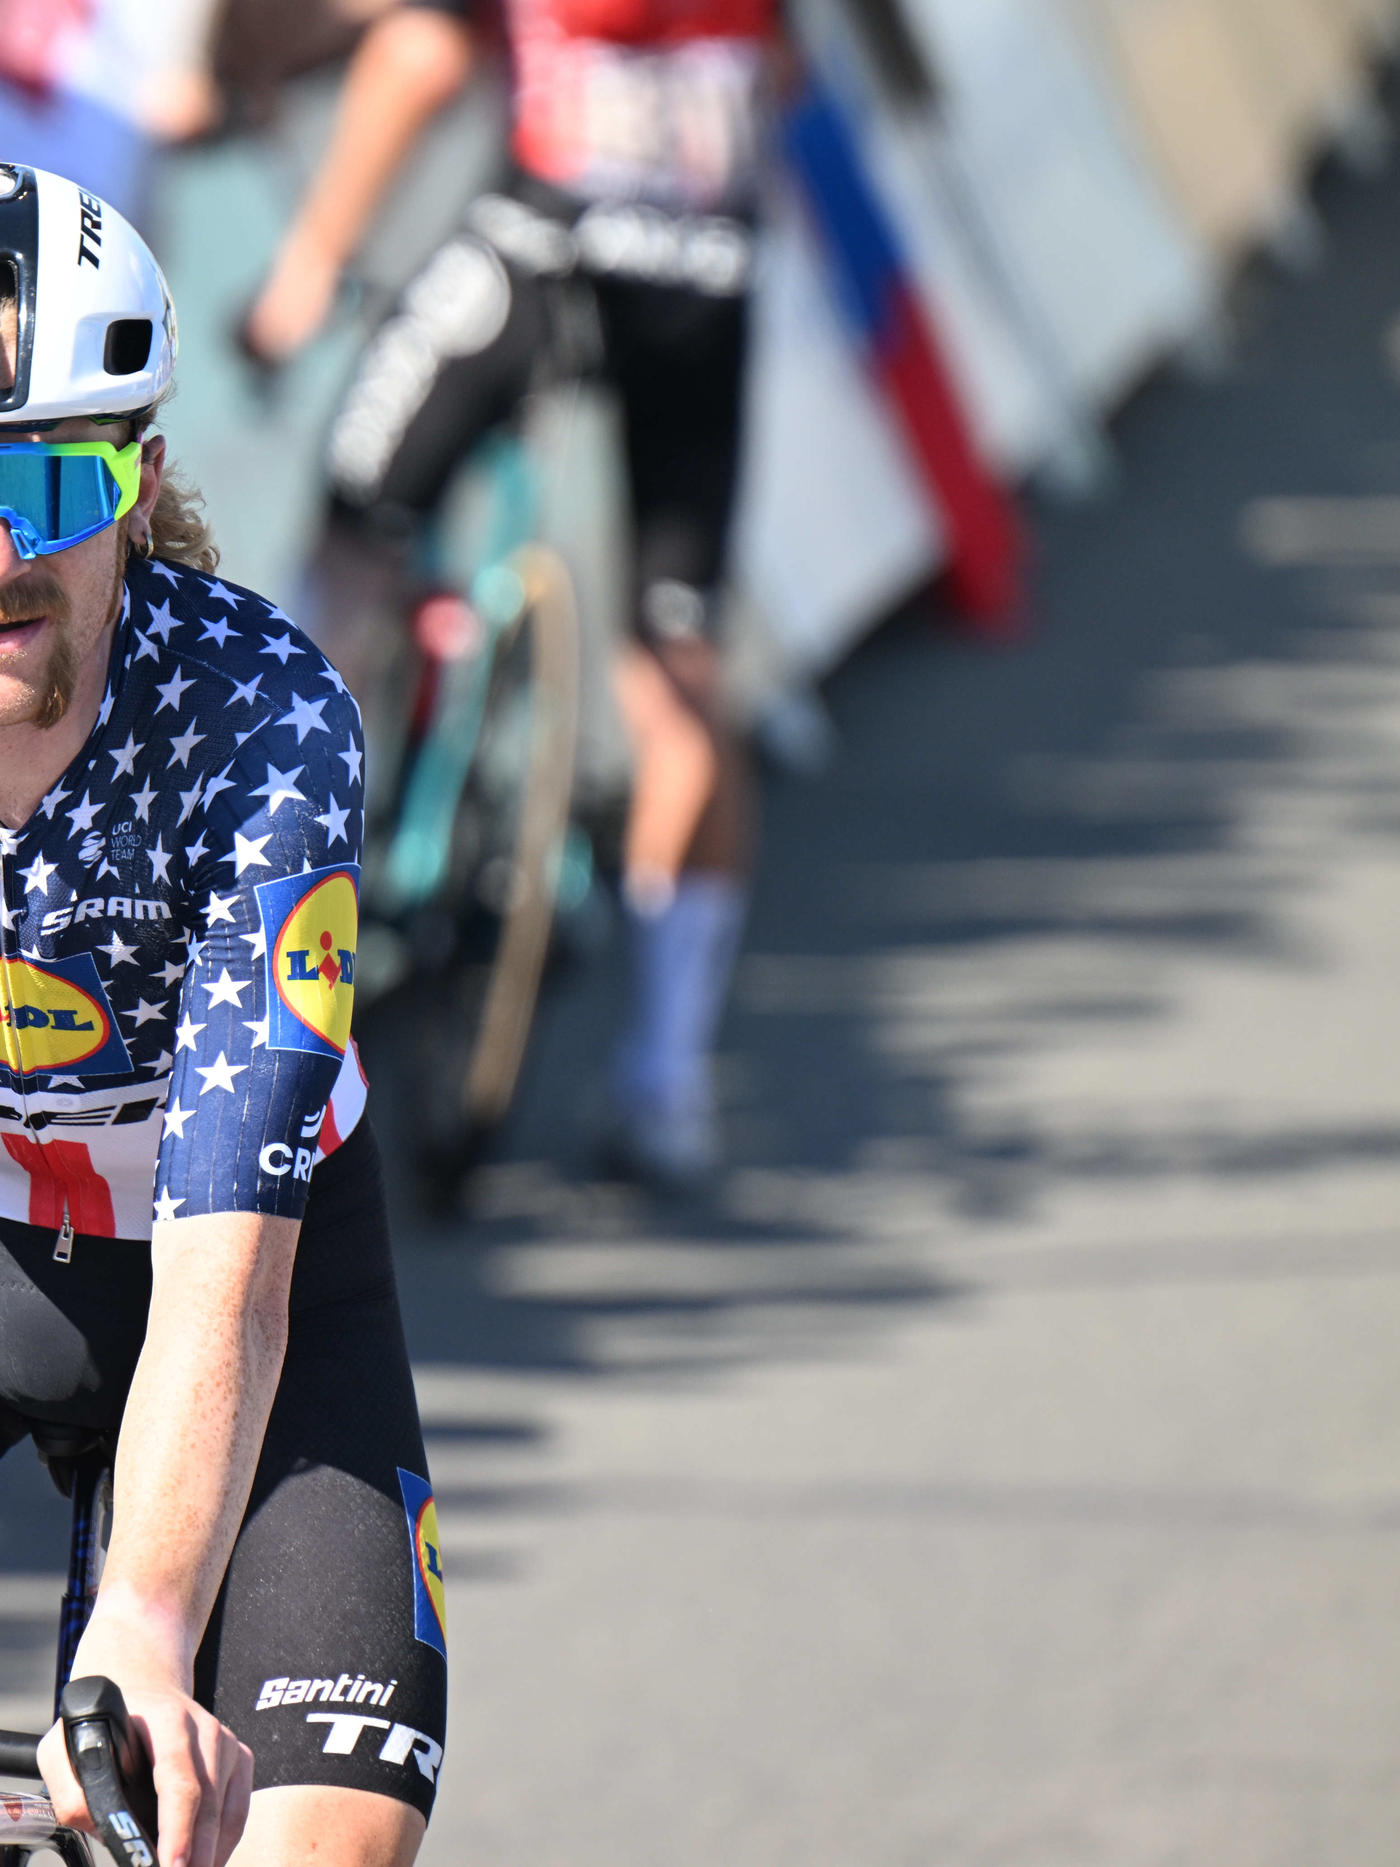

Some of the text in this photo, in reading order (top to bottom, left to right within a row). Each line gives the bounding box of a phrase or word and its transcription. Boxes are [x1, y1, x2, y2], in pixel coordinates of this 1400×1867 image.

[111, 820, 133, 836] UCI
[110, 847, 136, 861] TEAM
[40, 896, 173, 936] SRAM
[255, 1673, 398, 1711] Santini
